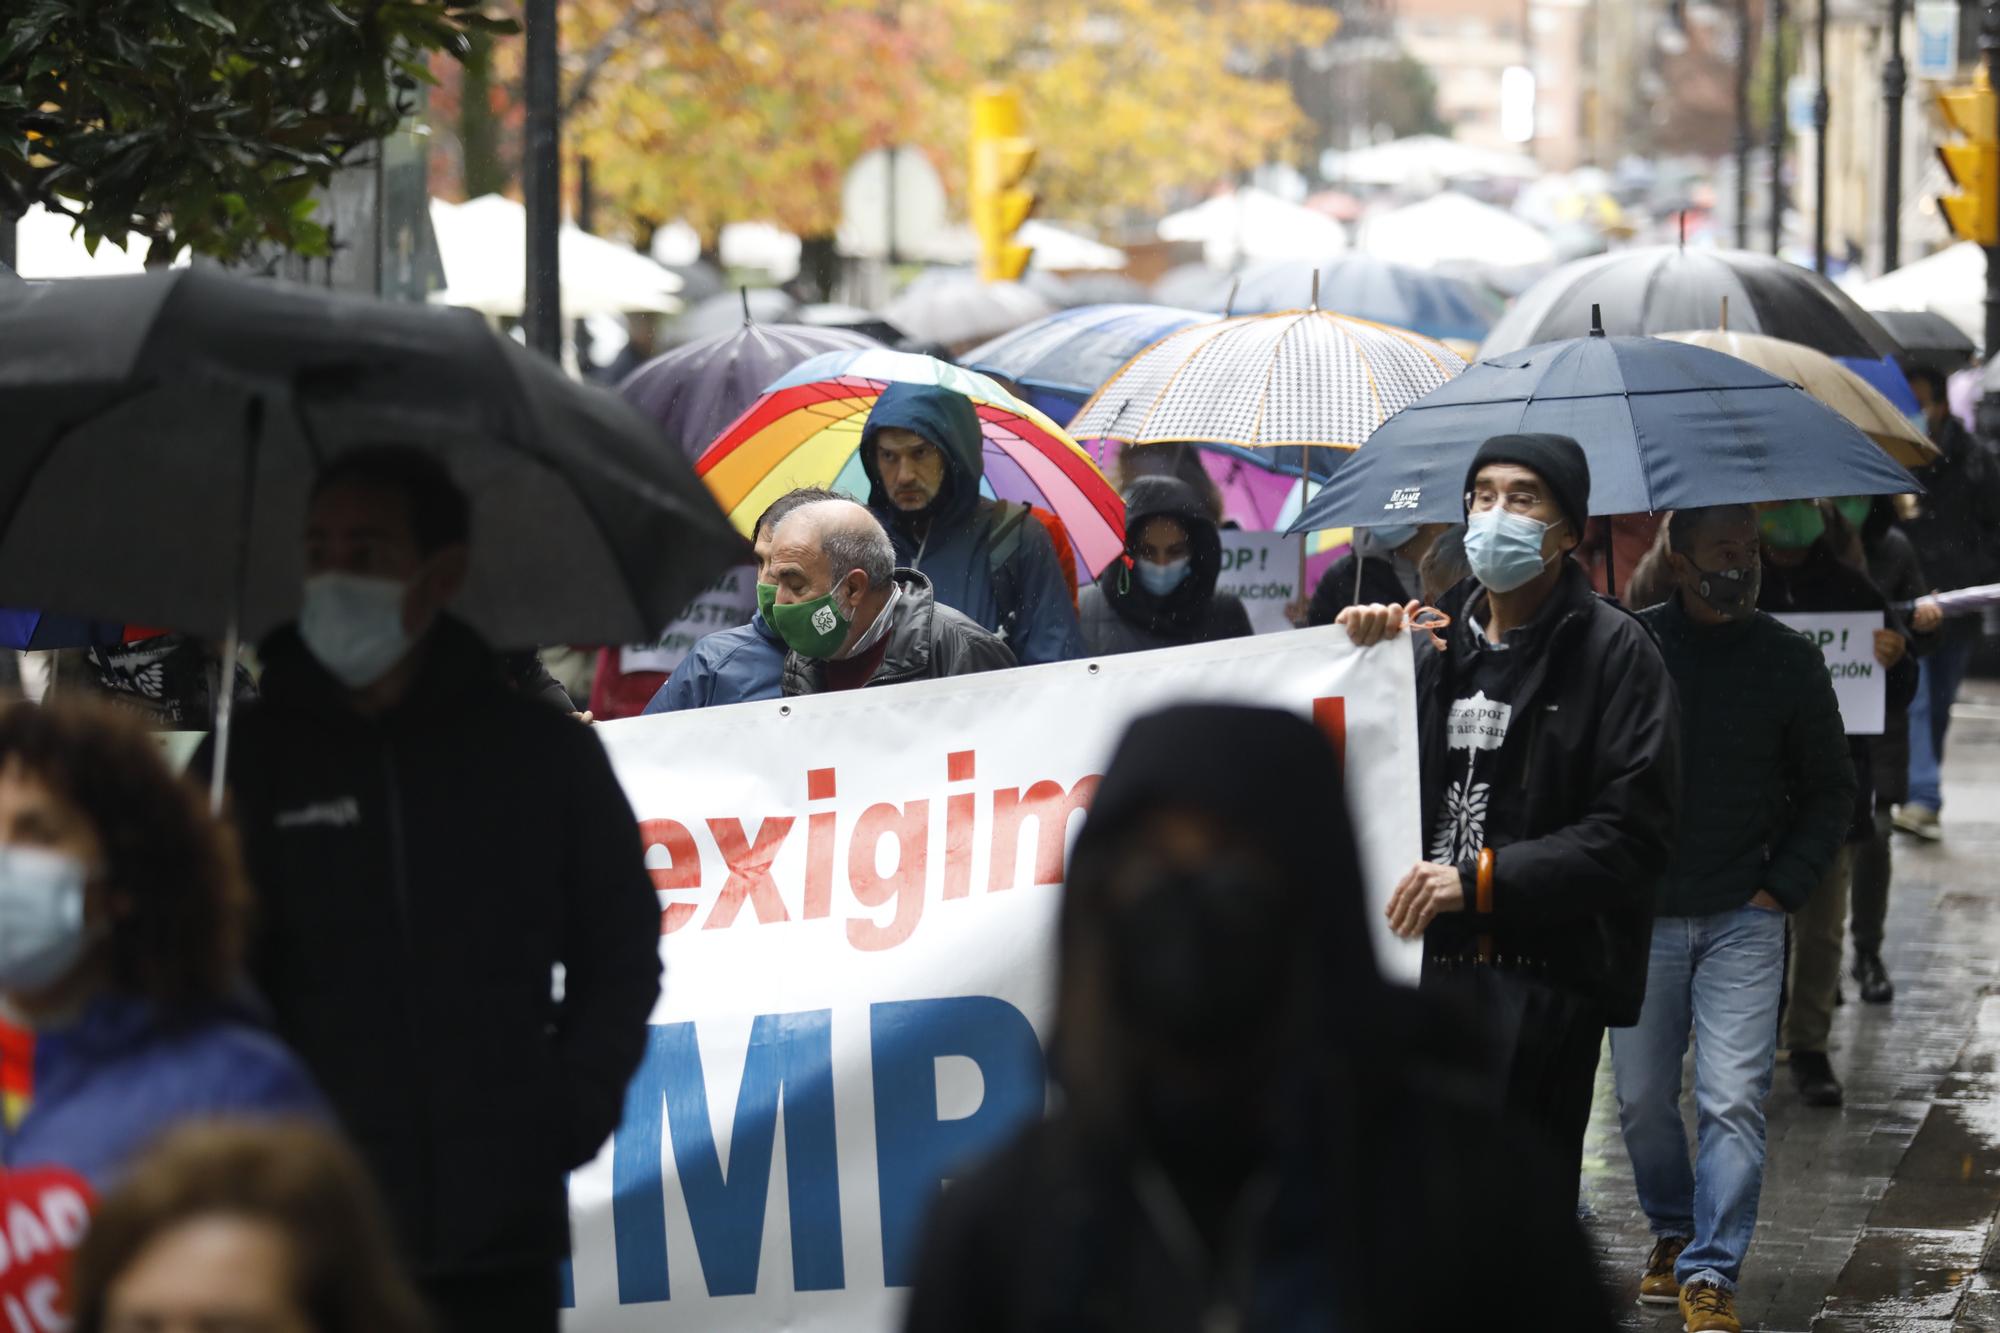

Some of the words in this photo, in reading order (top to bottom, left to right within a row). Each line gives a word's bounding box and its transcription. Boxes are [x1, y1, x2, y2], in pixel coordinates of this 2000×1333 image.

[1221, 548, 1254, 572] OP
[1236, 582, 1293, 601] ACIÓN
[1829, 661, 1872, 679] CIÓN
[1477, 708, 1504, 721] por
[1480, 726, 1505, 738] san
[644, 748, 1106, 952] exigim
[557, 995, 1046, 1307] MP
